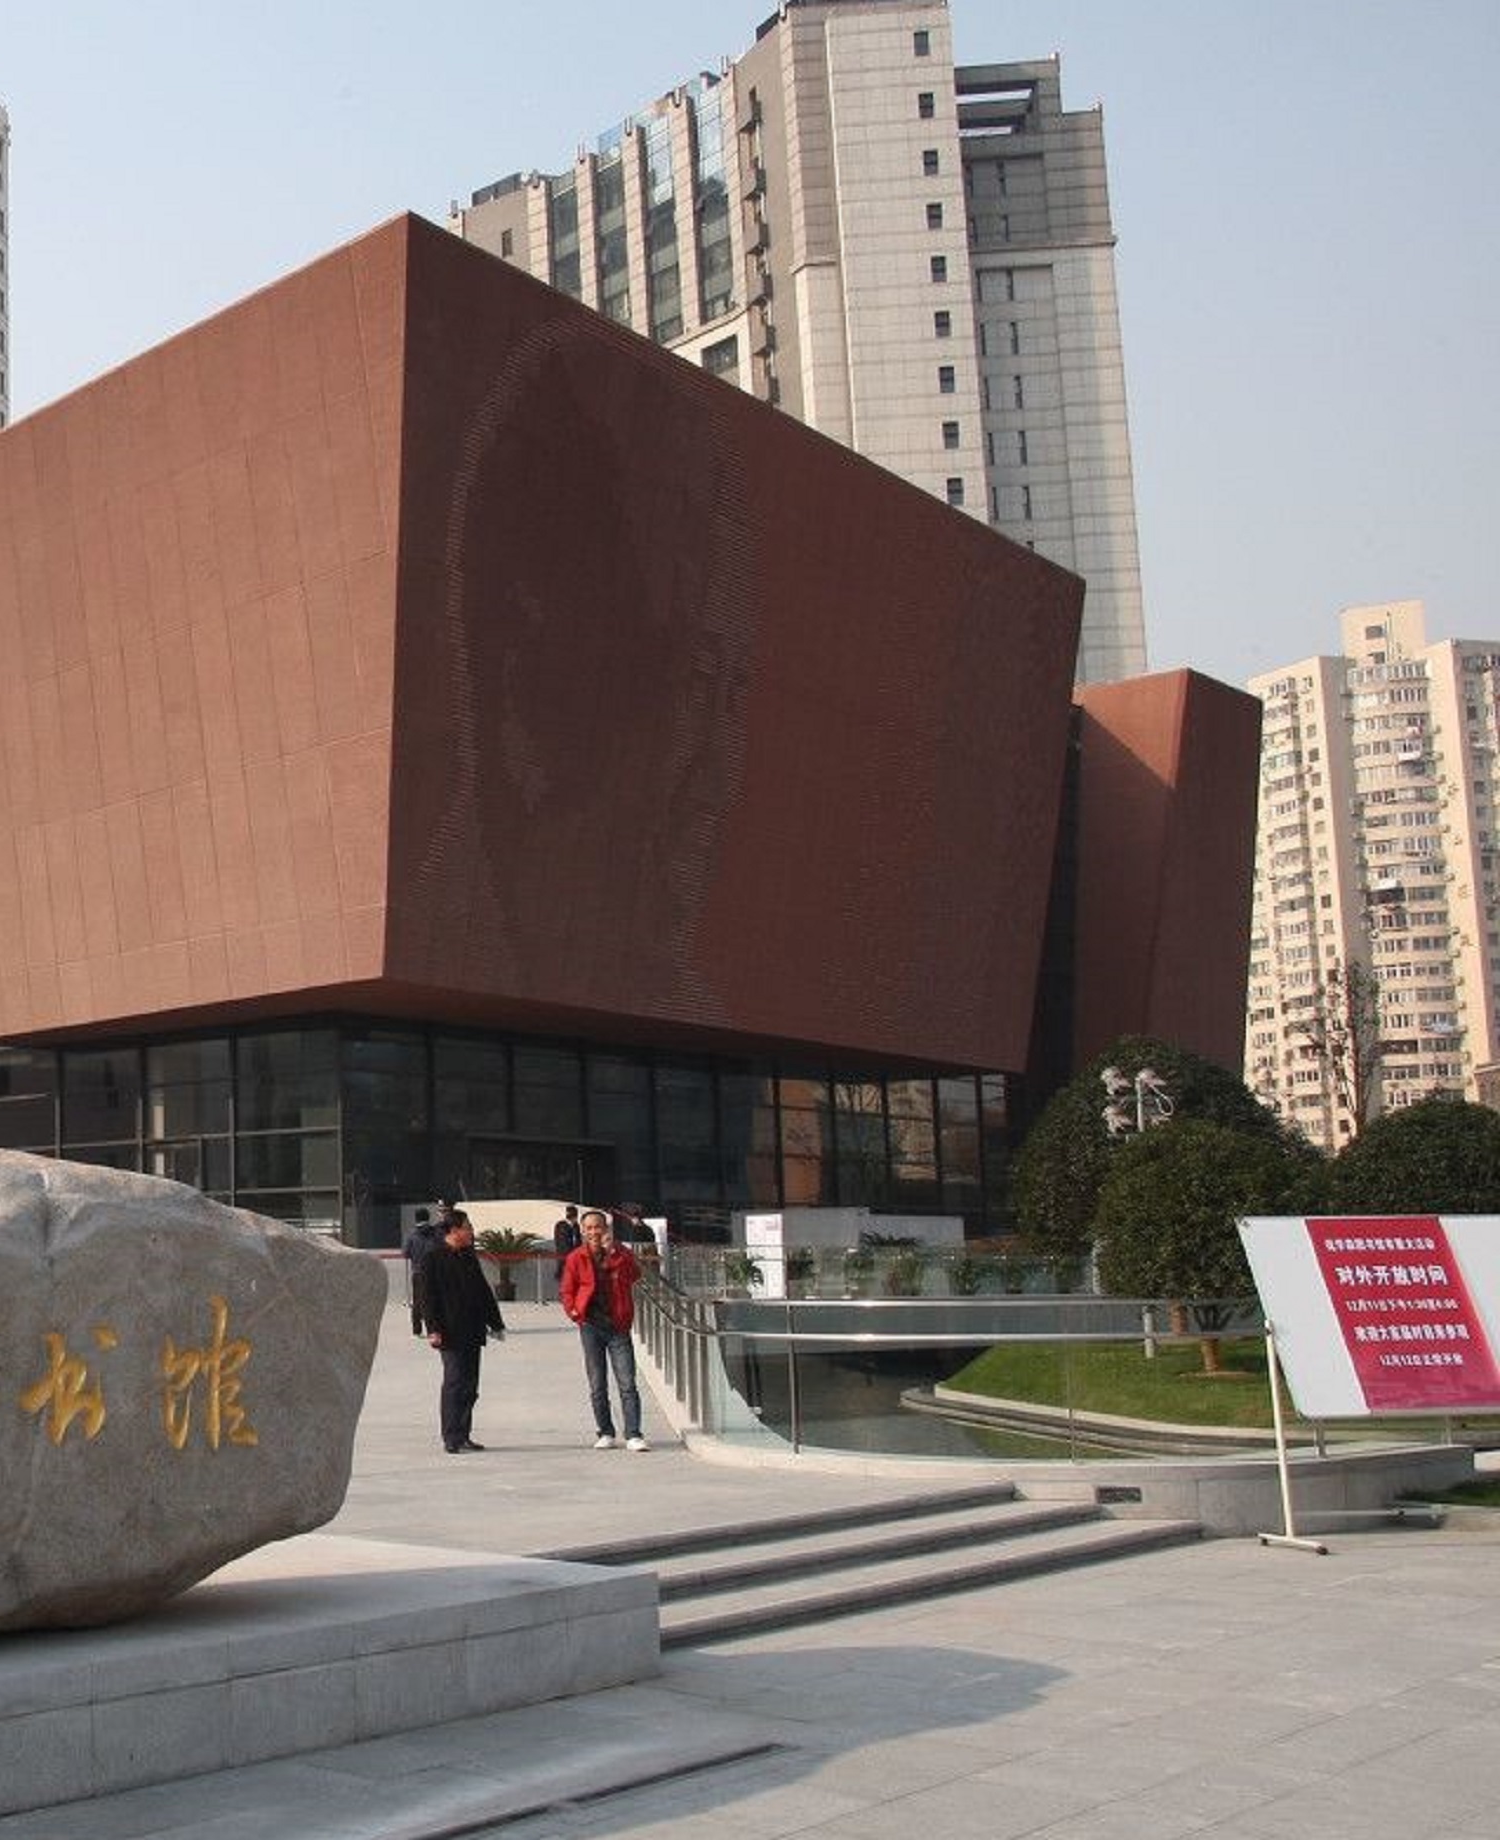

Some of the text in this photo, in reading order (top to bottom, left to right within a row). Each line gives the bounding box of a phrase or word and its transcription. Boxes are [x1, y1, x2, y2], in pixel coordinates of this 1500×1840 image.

[1335, 1264, 1448, 1286] 对外开放时间
